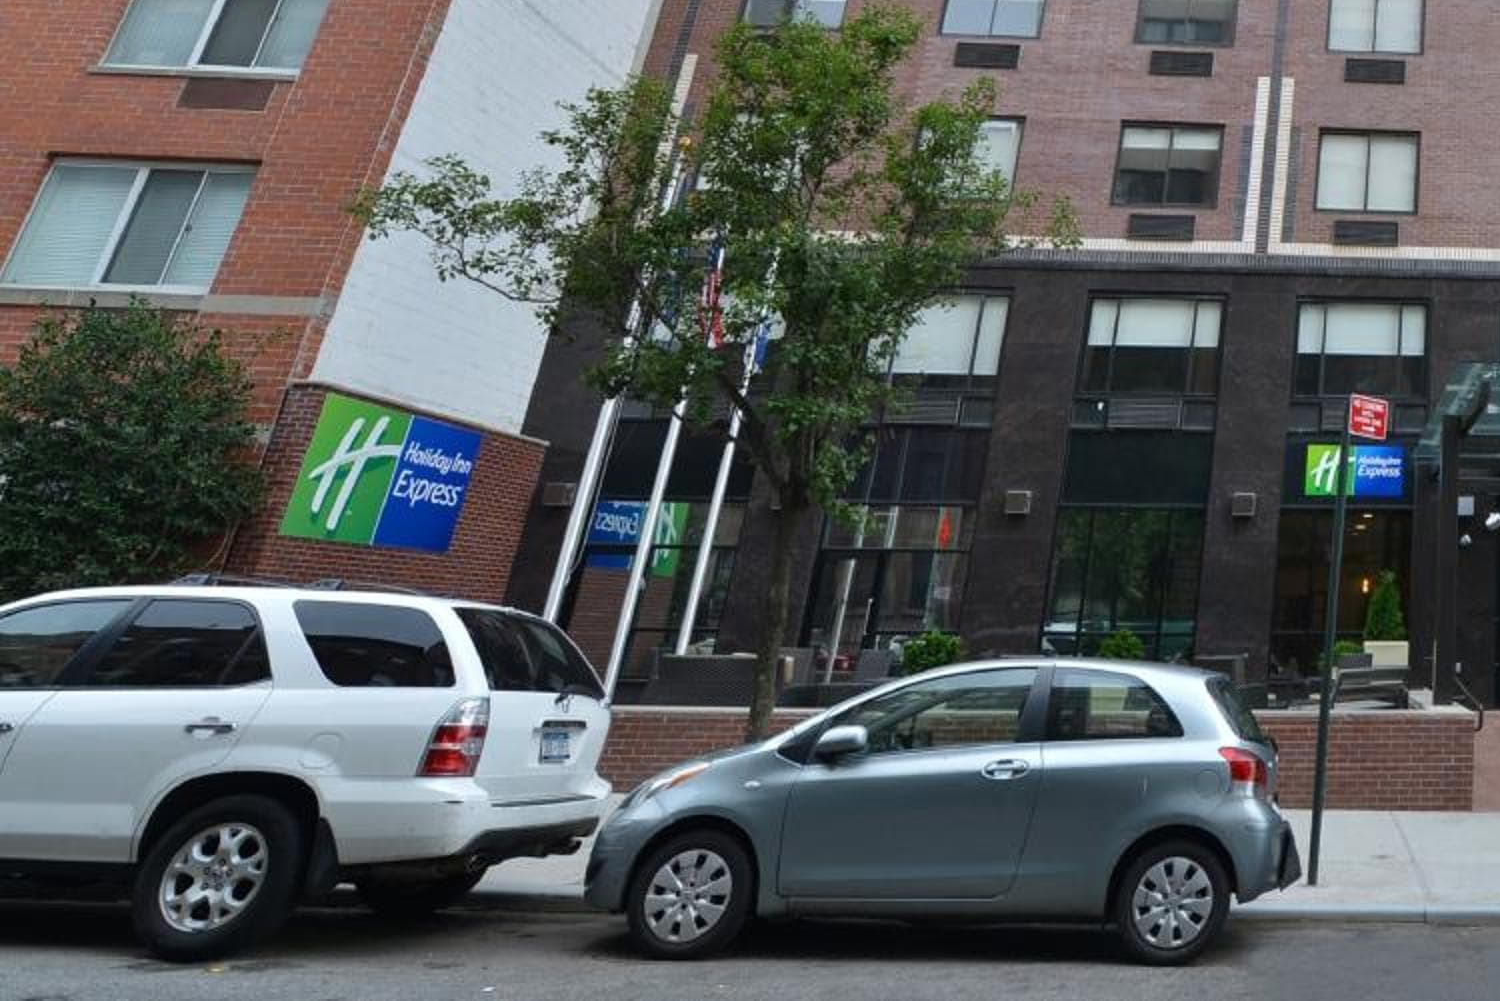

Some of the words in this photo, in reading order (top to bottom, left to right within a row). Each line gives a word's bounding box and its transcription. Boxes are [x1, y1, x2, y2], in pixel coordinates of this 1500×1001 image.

[404, 441, 452, 474] Holiday
[451, 452, 471, 474] Inn
[1358, 465, 1401, 479] Express
[393, 470, 462, 507] Express
